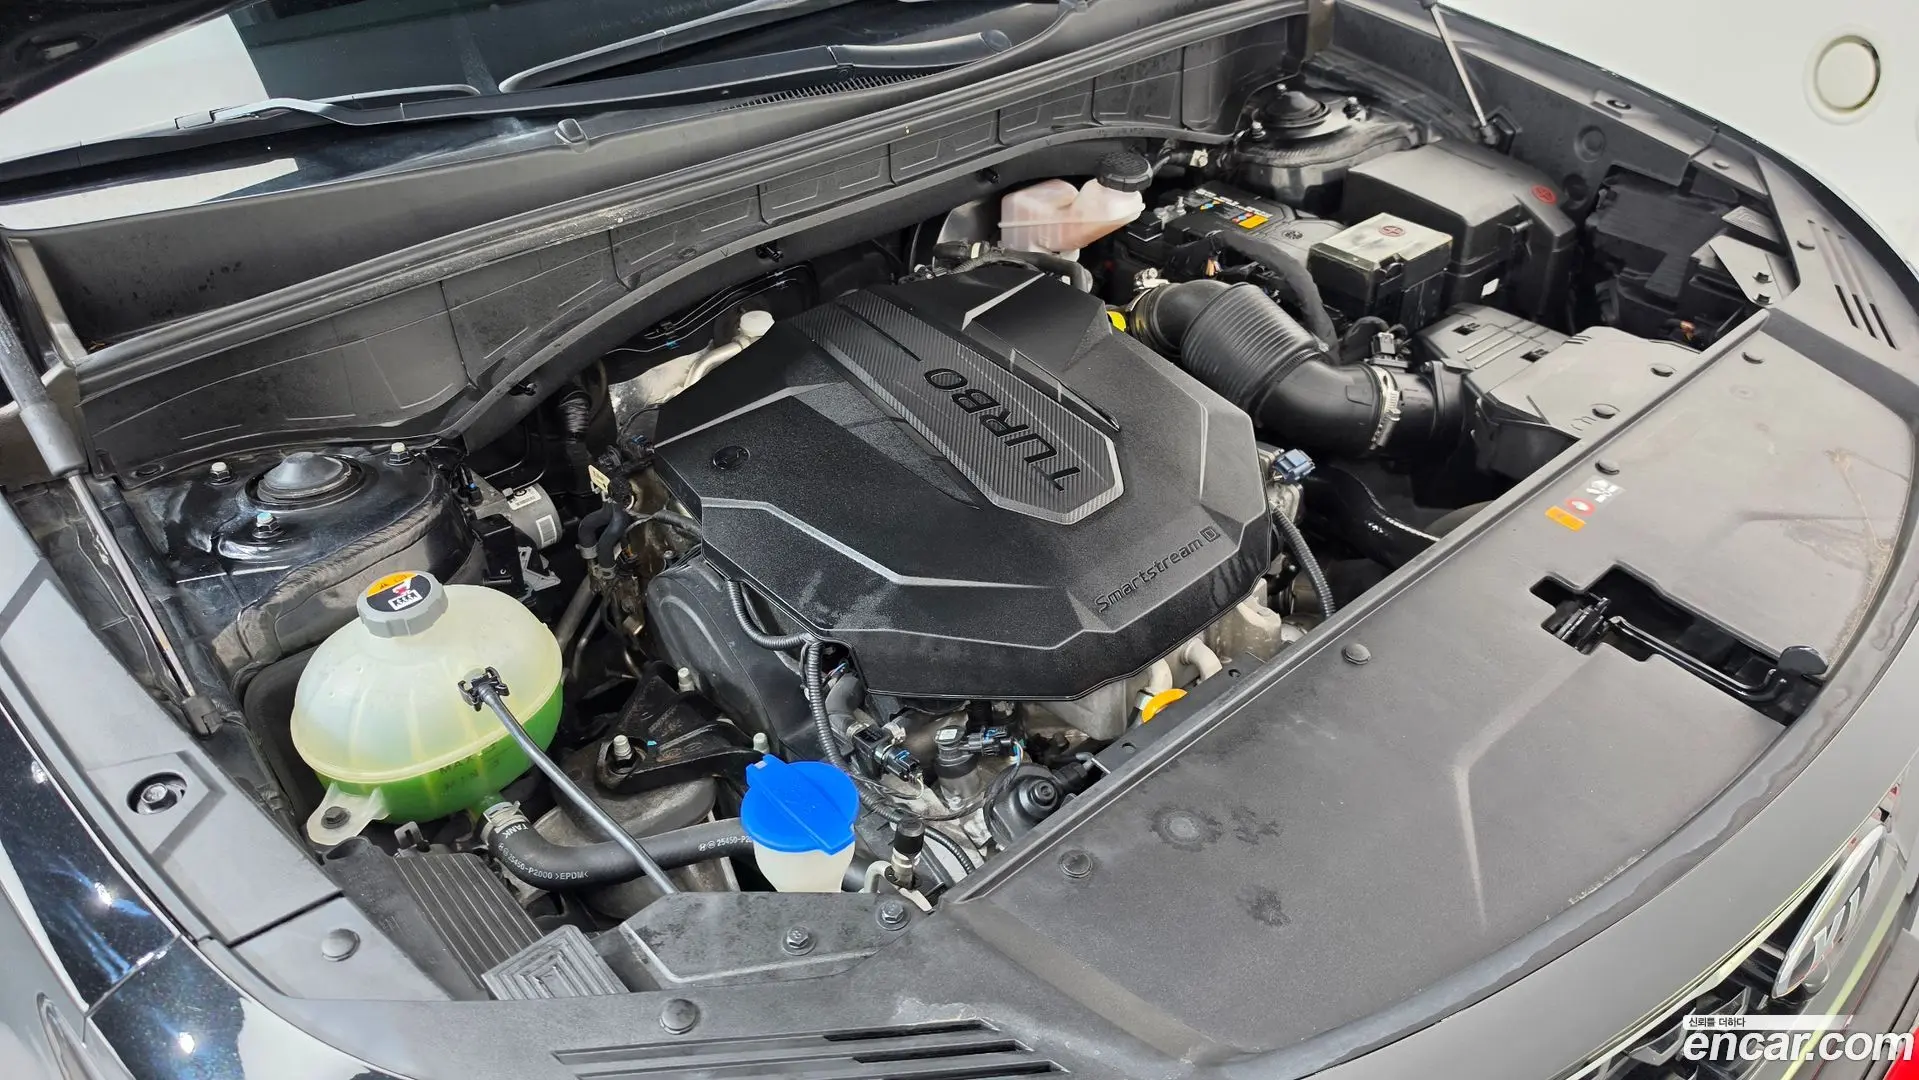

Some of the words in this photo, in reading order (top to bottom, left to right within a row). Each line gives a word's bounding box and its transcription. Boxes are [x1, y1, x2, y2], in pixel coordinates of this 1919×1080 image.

[924, 368, 1081, 492] TURBO
[1094, 538, 1204, 613] Smartstream
[502, 823, 529, 839] TANK
[507, 853, 553, 879] 25450-P2000
